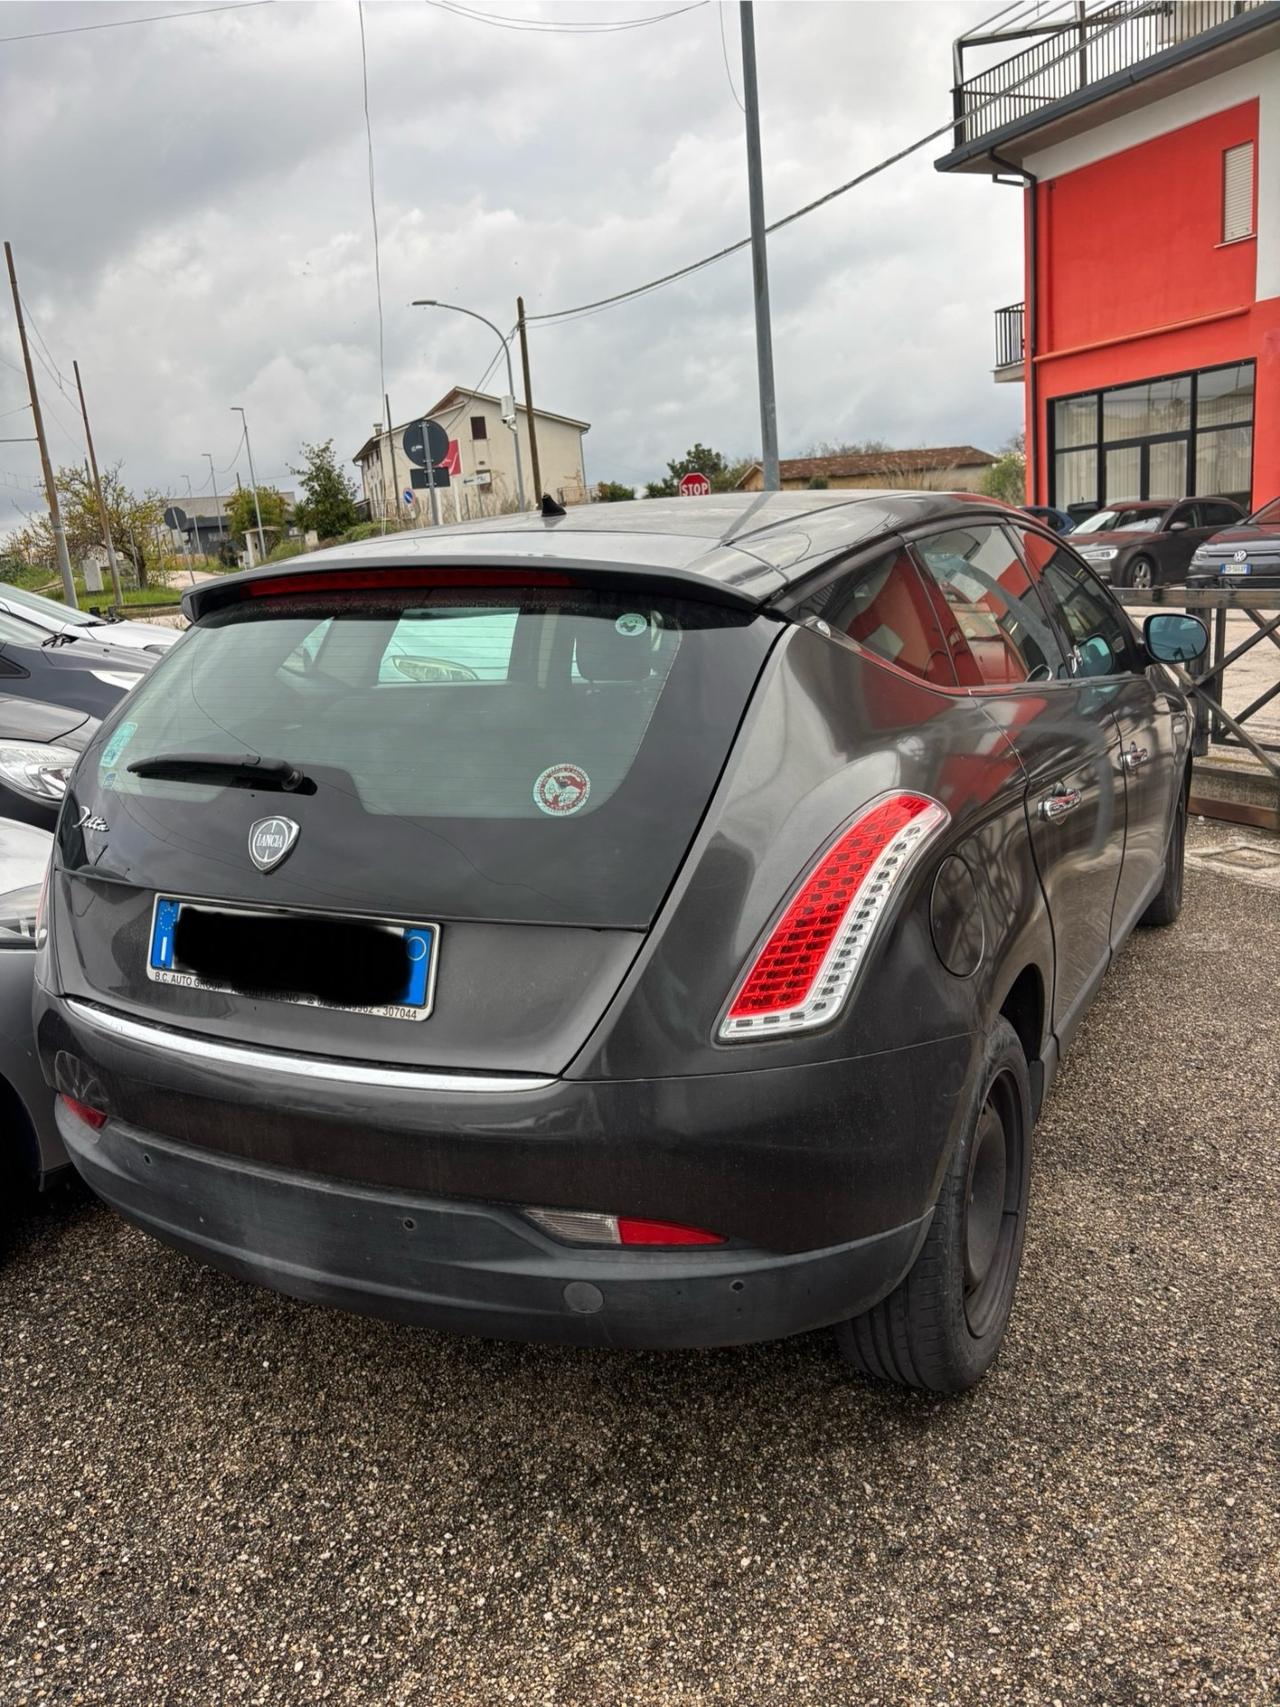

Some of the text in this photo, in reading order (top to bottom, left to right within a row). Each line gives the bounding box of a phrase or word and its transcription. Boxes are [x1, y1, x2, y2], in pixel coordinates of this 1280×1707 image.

[682, 482, 708, 496] STOP
[256, 833, 283, 848] LANCIA
[155, 971, 169, 983] B.C.
[171, 974, 193, 986] AUTO
[382, 1006, 417, 1019] 307044
